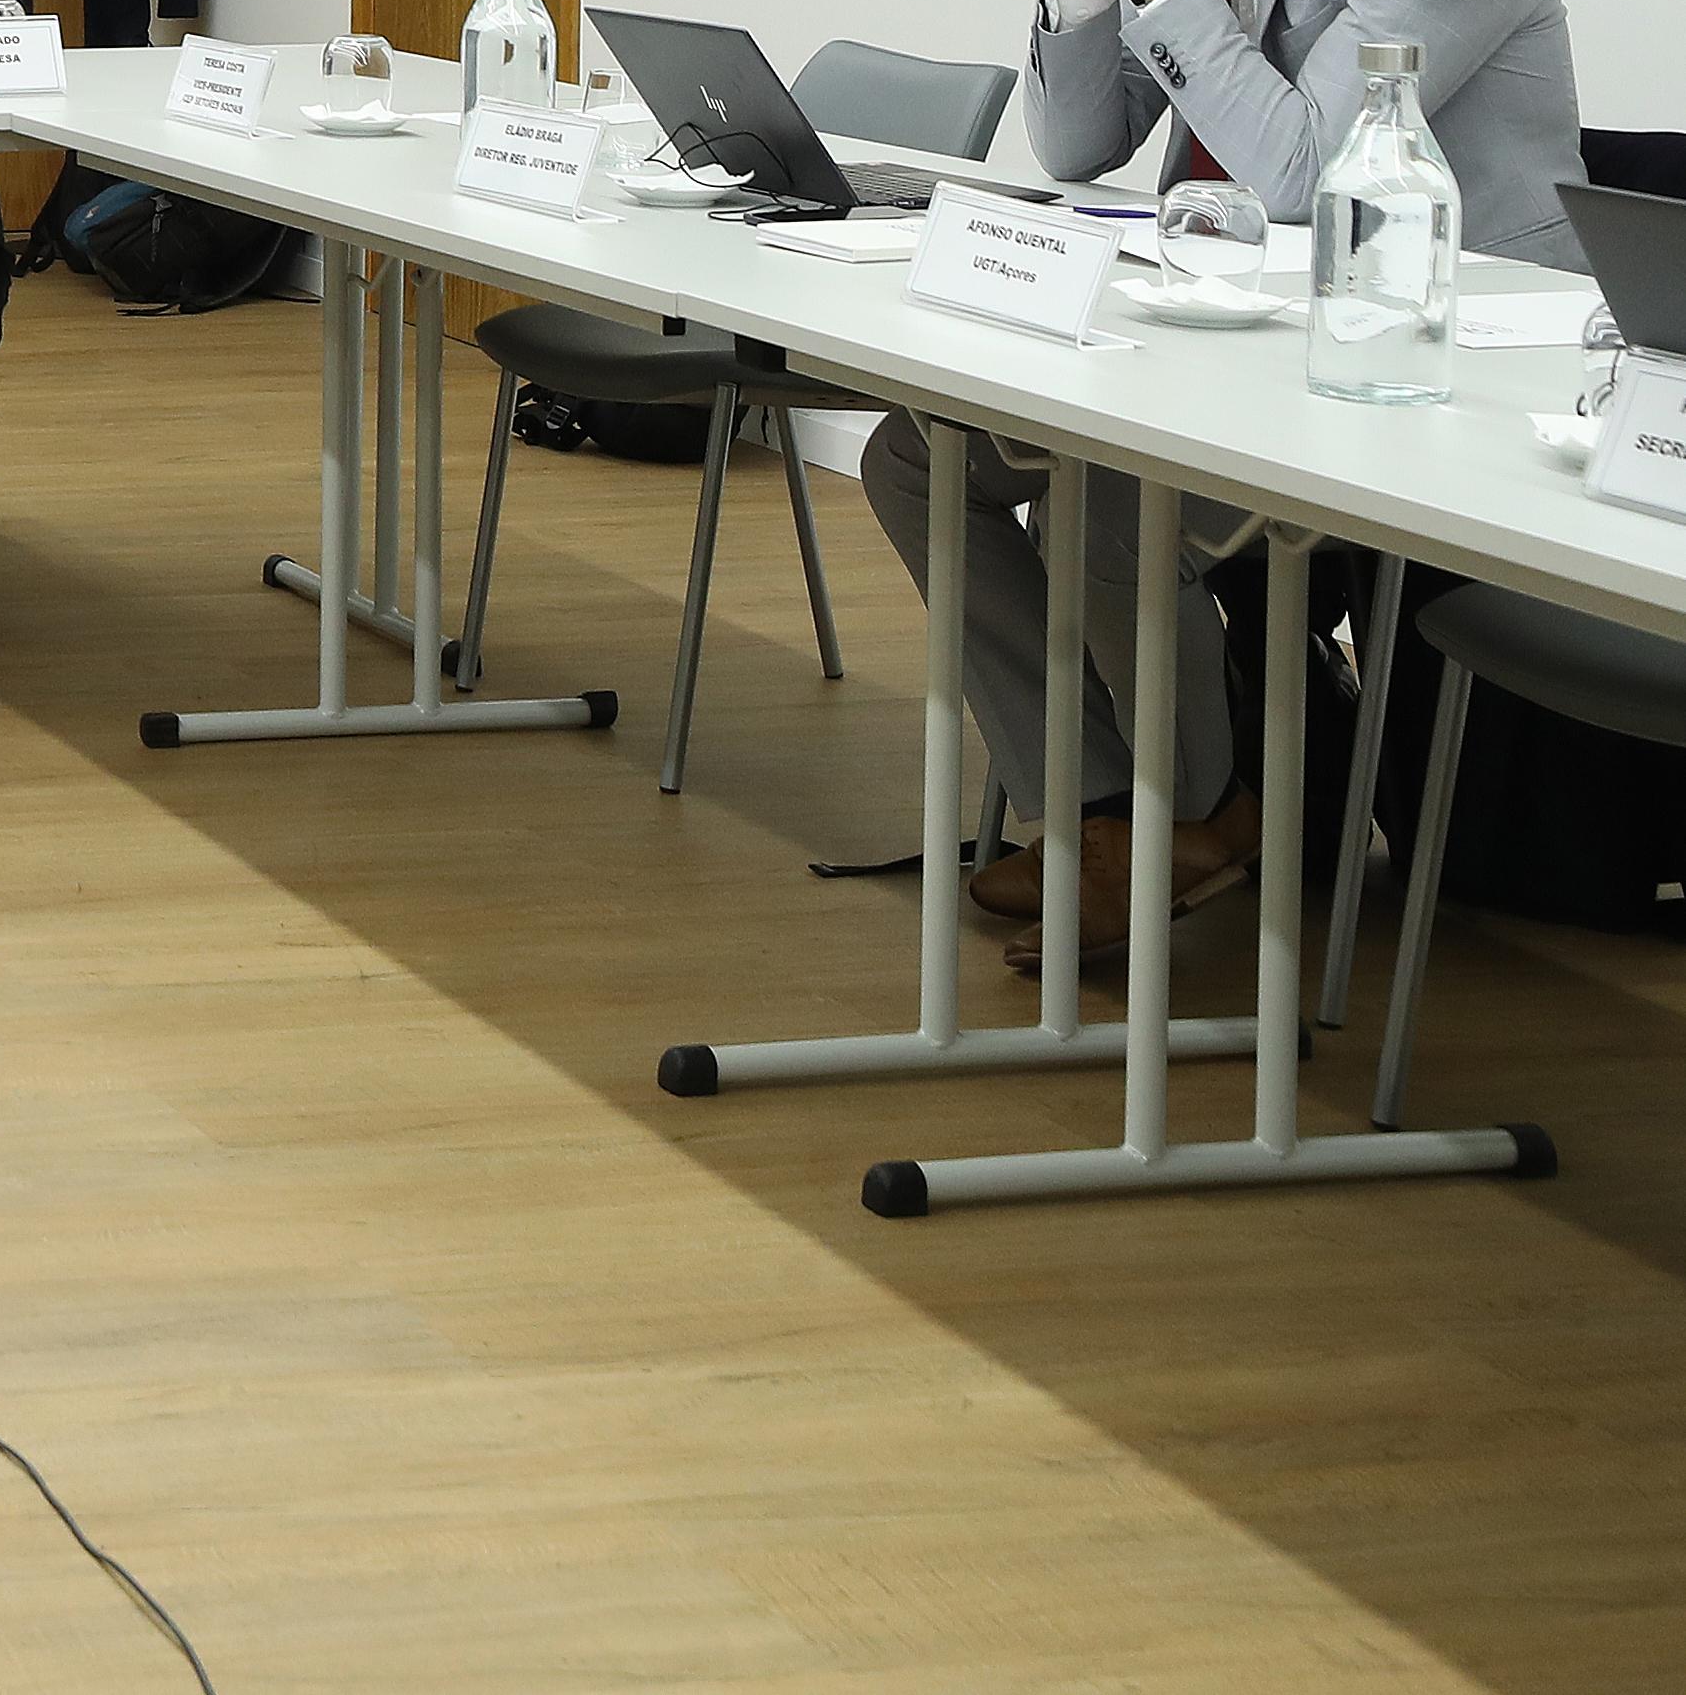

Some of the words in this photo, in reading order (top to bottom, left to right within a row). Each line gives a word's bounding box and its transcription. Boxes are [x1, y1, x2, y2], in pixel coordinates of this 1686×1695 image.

[535, 129, 563, 144] BRAGA
[474, 146, 509, 163] DIRETOR
[529, 156, 579, 176] JUVENTUDE
[966, 218, 1013, 241] AFONSO
[1015, 231, 1068, 255] QUENTAL
